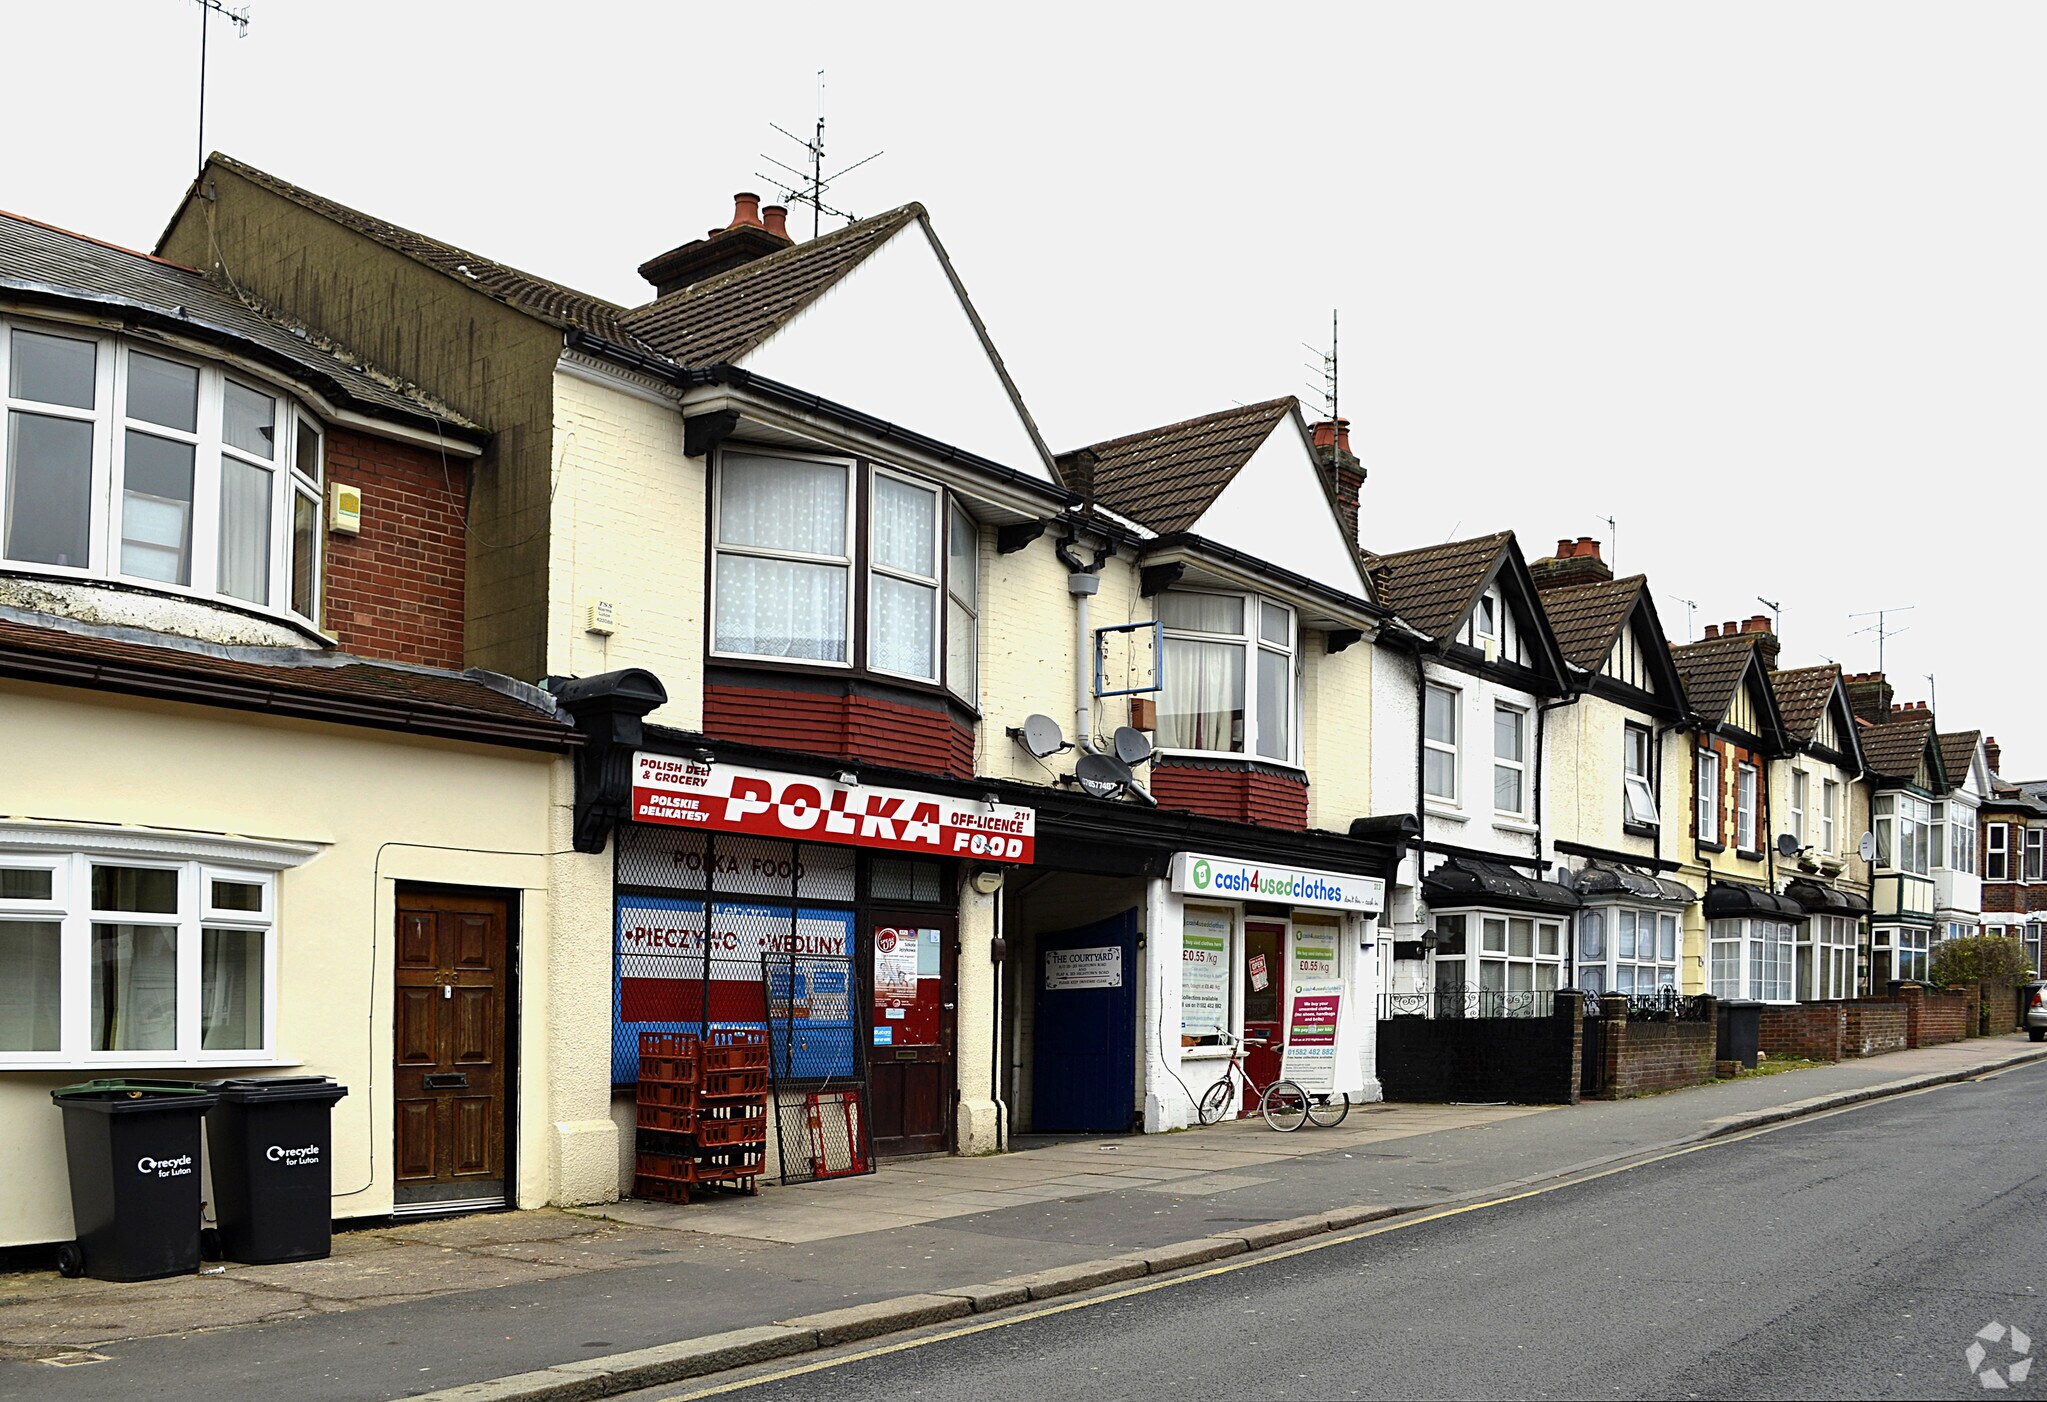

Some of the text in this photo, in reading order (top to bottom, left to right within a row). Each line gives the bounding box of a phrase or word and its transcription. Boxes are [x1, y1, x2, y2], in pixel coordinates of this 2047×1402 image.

[640, 758, 710, 777] POLISH DELI
[642, 770, 708, 787] & GROCERY
[650, 794, 700, 810] POLSKIE
[639, 805, 710, 822] DELIKATESY
[724, 776, 940, 845] POLKA
[1014, 812, 1030, 821] 211
[950, 812, 1024, 834] OFF-LICENCE
[952, 832, 1023, 858] FOOD
[1215, 868, 1342, 902] cash4usedclothes
[1053, 952, 1113, 964] THE COURTYARD
[1182, 950, 1218, 966] £0.55 /kg
[1300, 960, 1329, 973] £0.55 /kg
[285, 1144, 320, 1158] recycle
[157, 1155, 192, 1170] recycle
[286, 1156, 319, 1166] for Luton
[158, 1166, 191, 1178] for Luton
